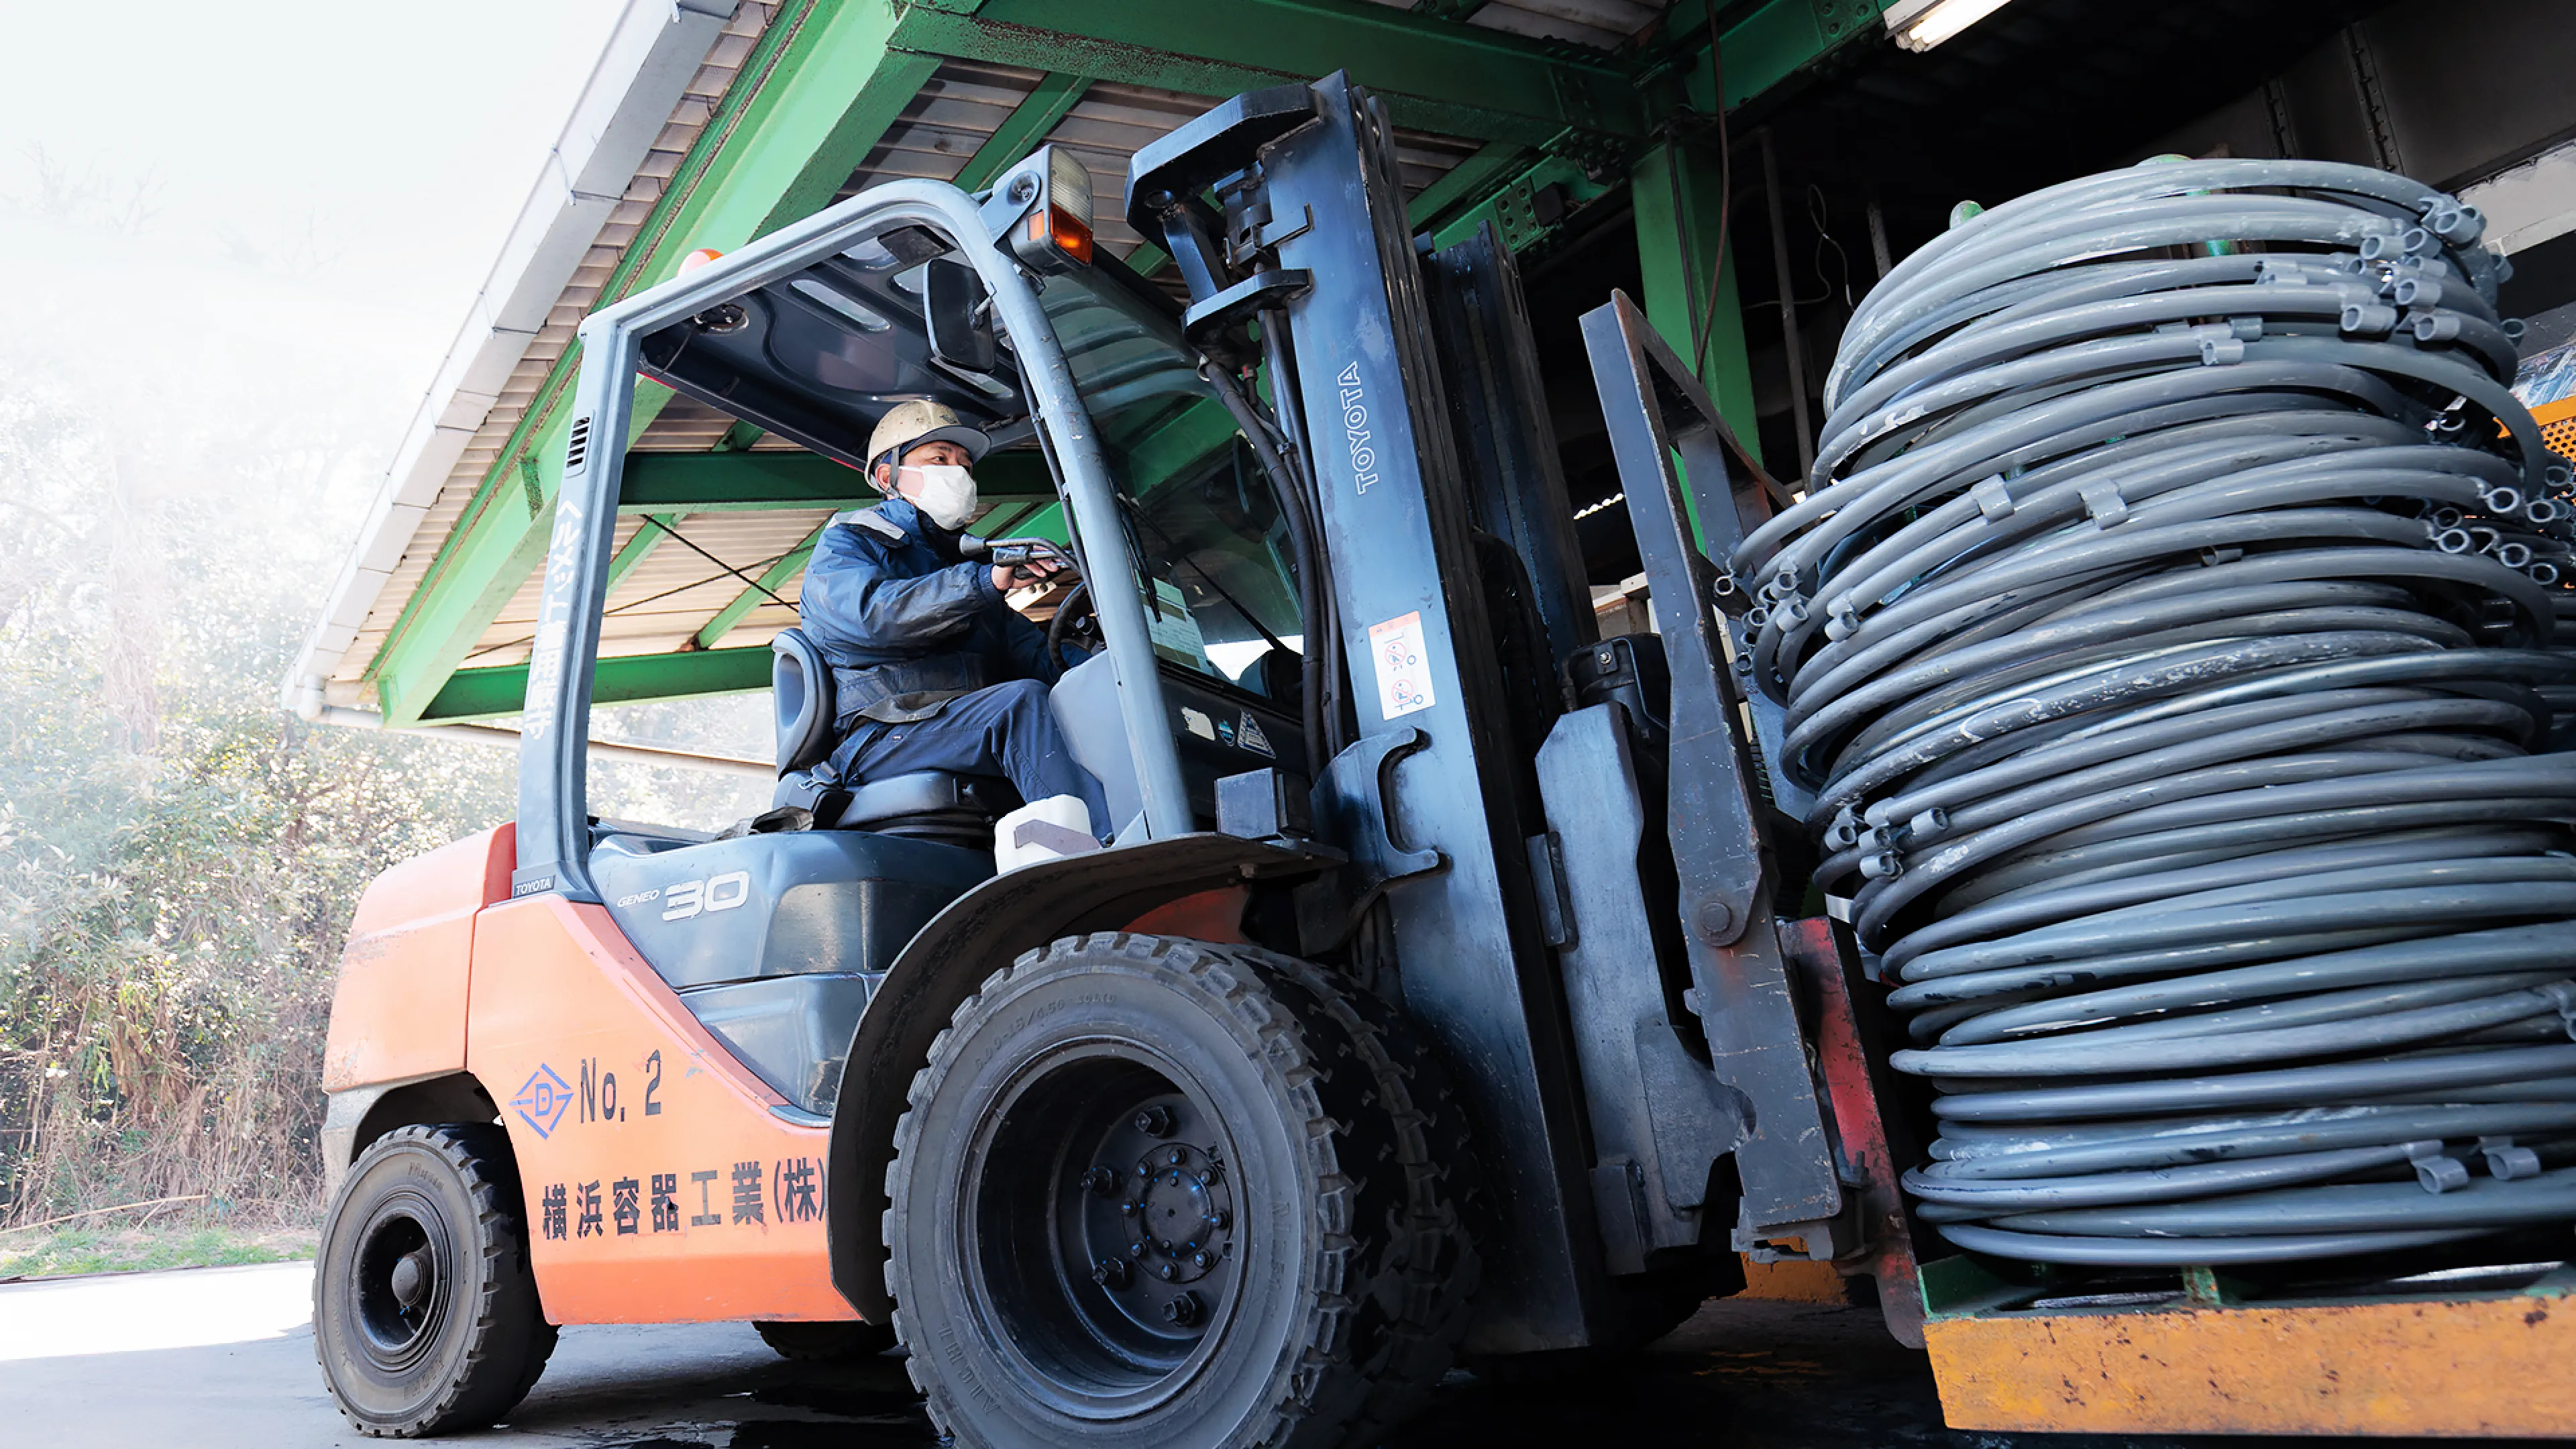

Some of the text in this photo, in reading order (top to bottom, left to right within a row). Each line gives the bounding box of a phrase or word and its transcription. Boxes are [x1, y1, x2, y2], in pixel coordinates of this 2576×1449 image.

[1337, 360, 1379, 496] TOYOTA
[514, 876, 552, 897] TOYOTA
[617, 870, 751, 922] GENEO 30
[580, 1049, 663, 1124] No. 2
